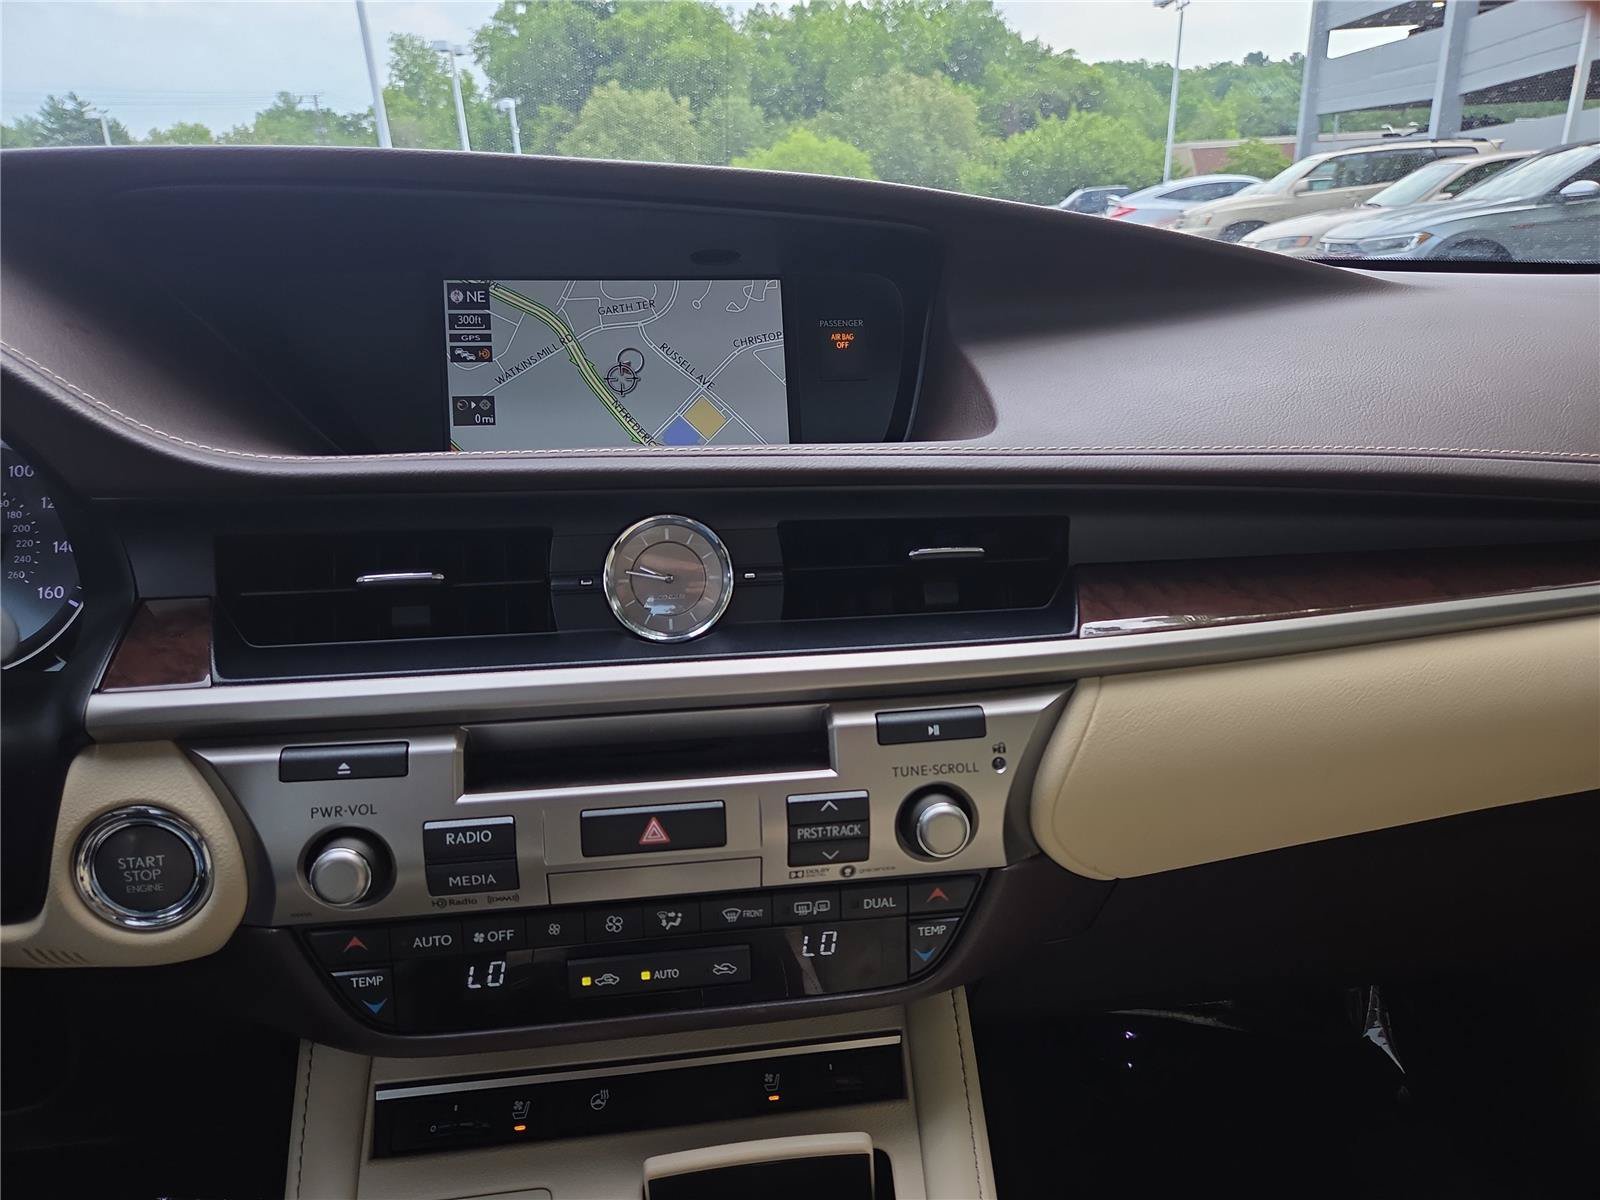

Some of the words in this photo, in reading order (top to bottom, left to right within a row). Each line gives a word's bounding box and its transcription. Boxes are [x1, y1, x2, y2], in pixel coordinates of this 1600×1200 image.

[467, 291, 486, 303] NE
[597, 303, 633, 316] GARTH
[636, 299, 656, 309] TER
[458, 315, 482, 325] 300ft
[819, 319, 864, 327] PASSENGER
[733, 331, 783, 348] CHRISTOP
[831, 333, 841, 341] AIR
[842, 333, 855, 341] BAG
[836, 341, 850, 349] OFF
[494, 355, 538, 385] WATKINS
[537, 343, 560, 361] MILL
[559, 334, 573, 346] RD
[660, 342, 696, 376] RUSSELL
[697, 374, 716, 390] AVE
[475, 413, 481, 424] 0
[482, 415, 494, 423] mi
[9, 464, 34, 478] 100
[7, 510, 22, 519] 180
[13, 524, 31, 533] 200
[16, 539, 34, 548] 220
[14, 555, 32, 564] 240
[8, 570, 26, 579] 260
[37, 585, 65, 599] 160
[446, 830, 492, 845] RADIO
[117, 854, 165, 869] START
[123, 868, 161, 882] STOP
[448, 874, 497, 887] MEDIA
[126, 882, 165, 893] ENGINE
[863, 898, 896, 909] DUAL
[743, 908, 763, 918] FRONT
[487, 929, 515, 943] OFF
[917, 925, 947, 937] TEMP
[413, 934, 453, 949] AUTO
[654, 968, 679, 980] AUTO
[350, 975, 384, 988] TEMP
